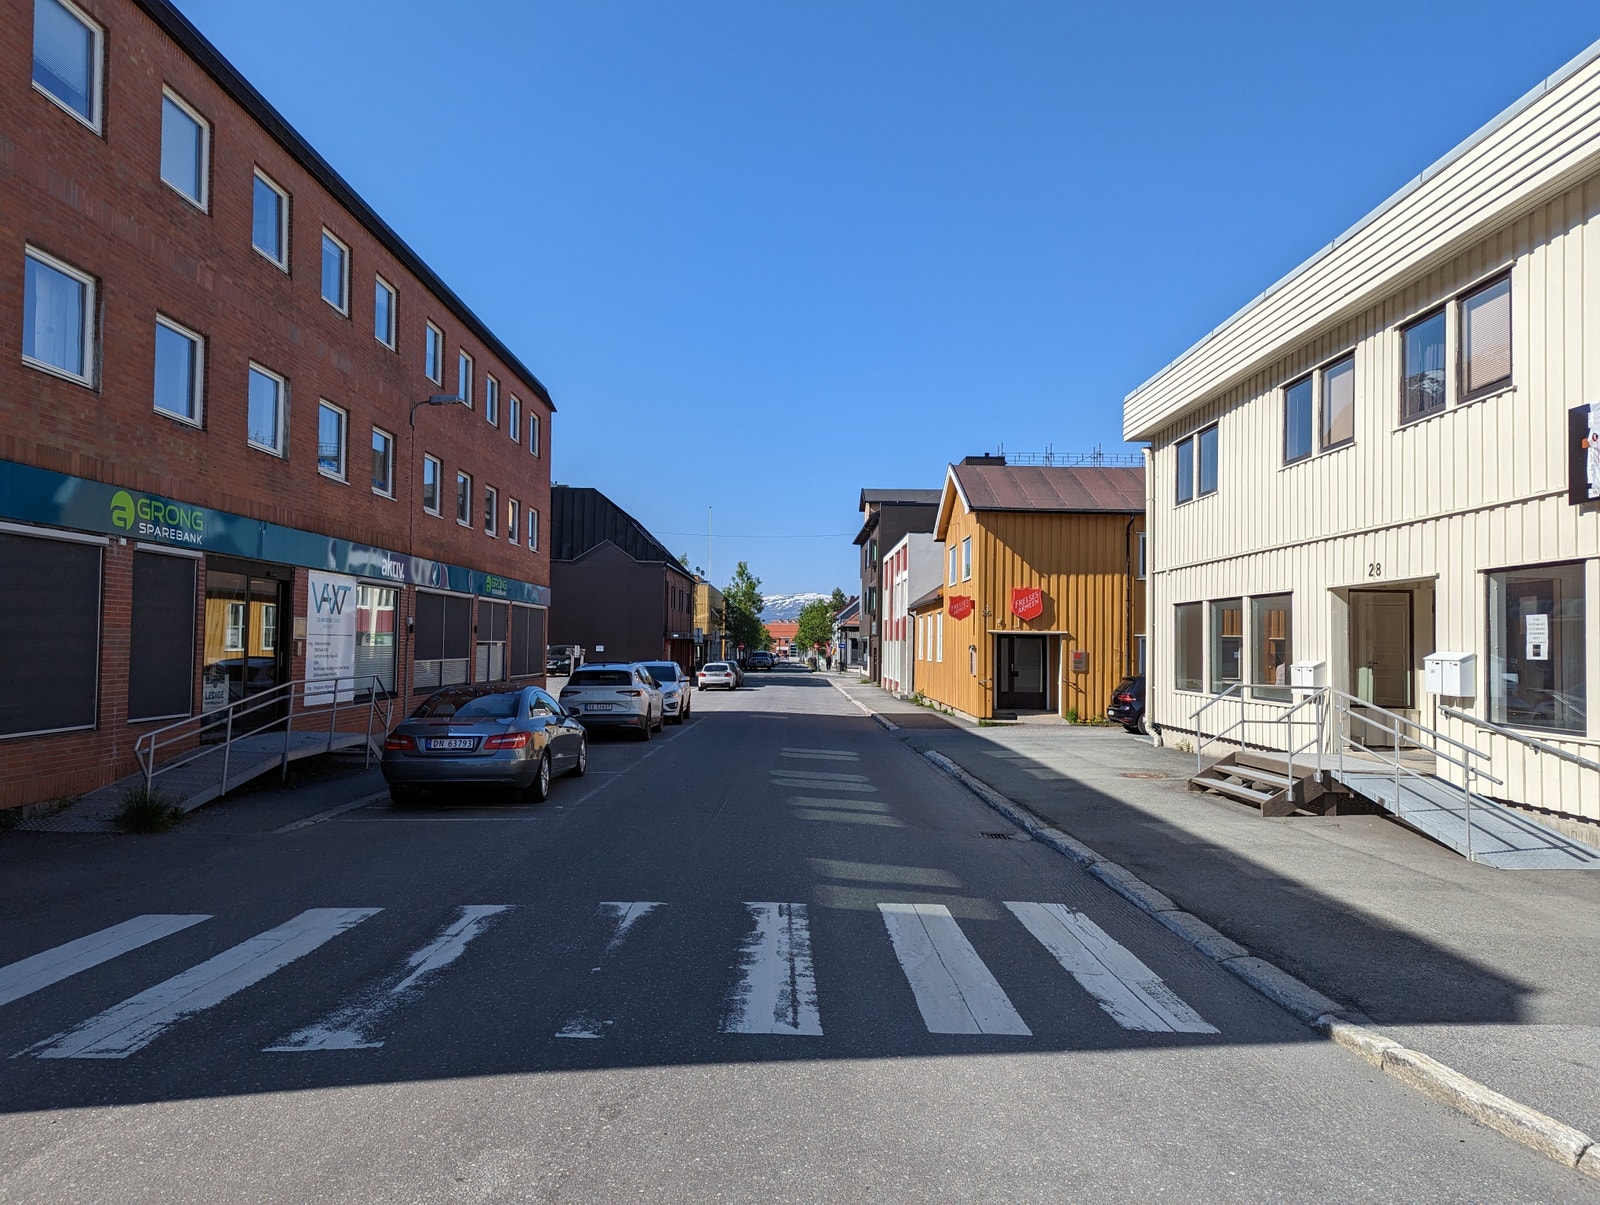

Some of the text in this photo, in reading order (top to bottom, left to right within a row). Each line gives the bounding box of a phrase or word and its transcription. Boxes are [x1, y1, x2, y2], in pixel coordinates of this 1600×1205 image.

[137, 498, 204, 531] GRONG
[138, 522, 203, 545] SPAREBANK
[1368, 562, 1382, 577] 28
[1014, 591, 1039, 609] FRELSES
[433, 739, 472, 748] DN 63793
